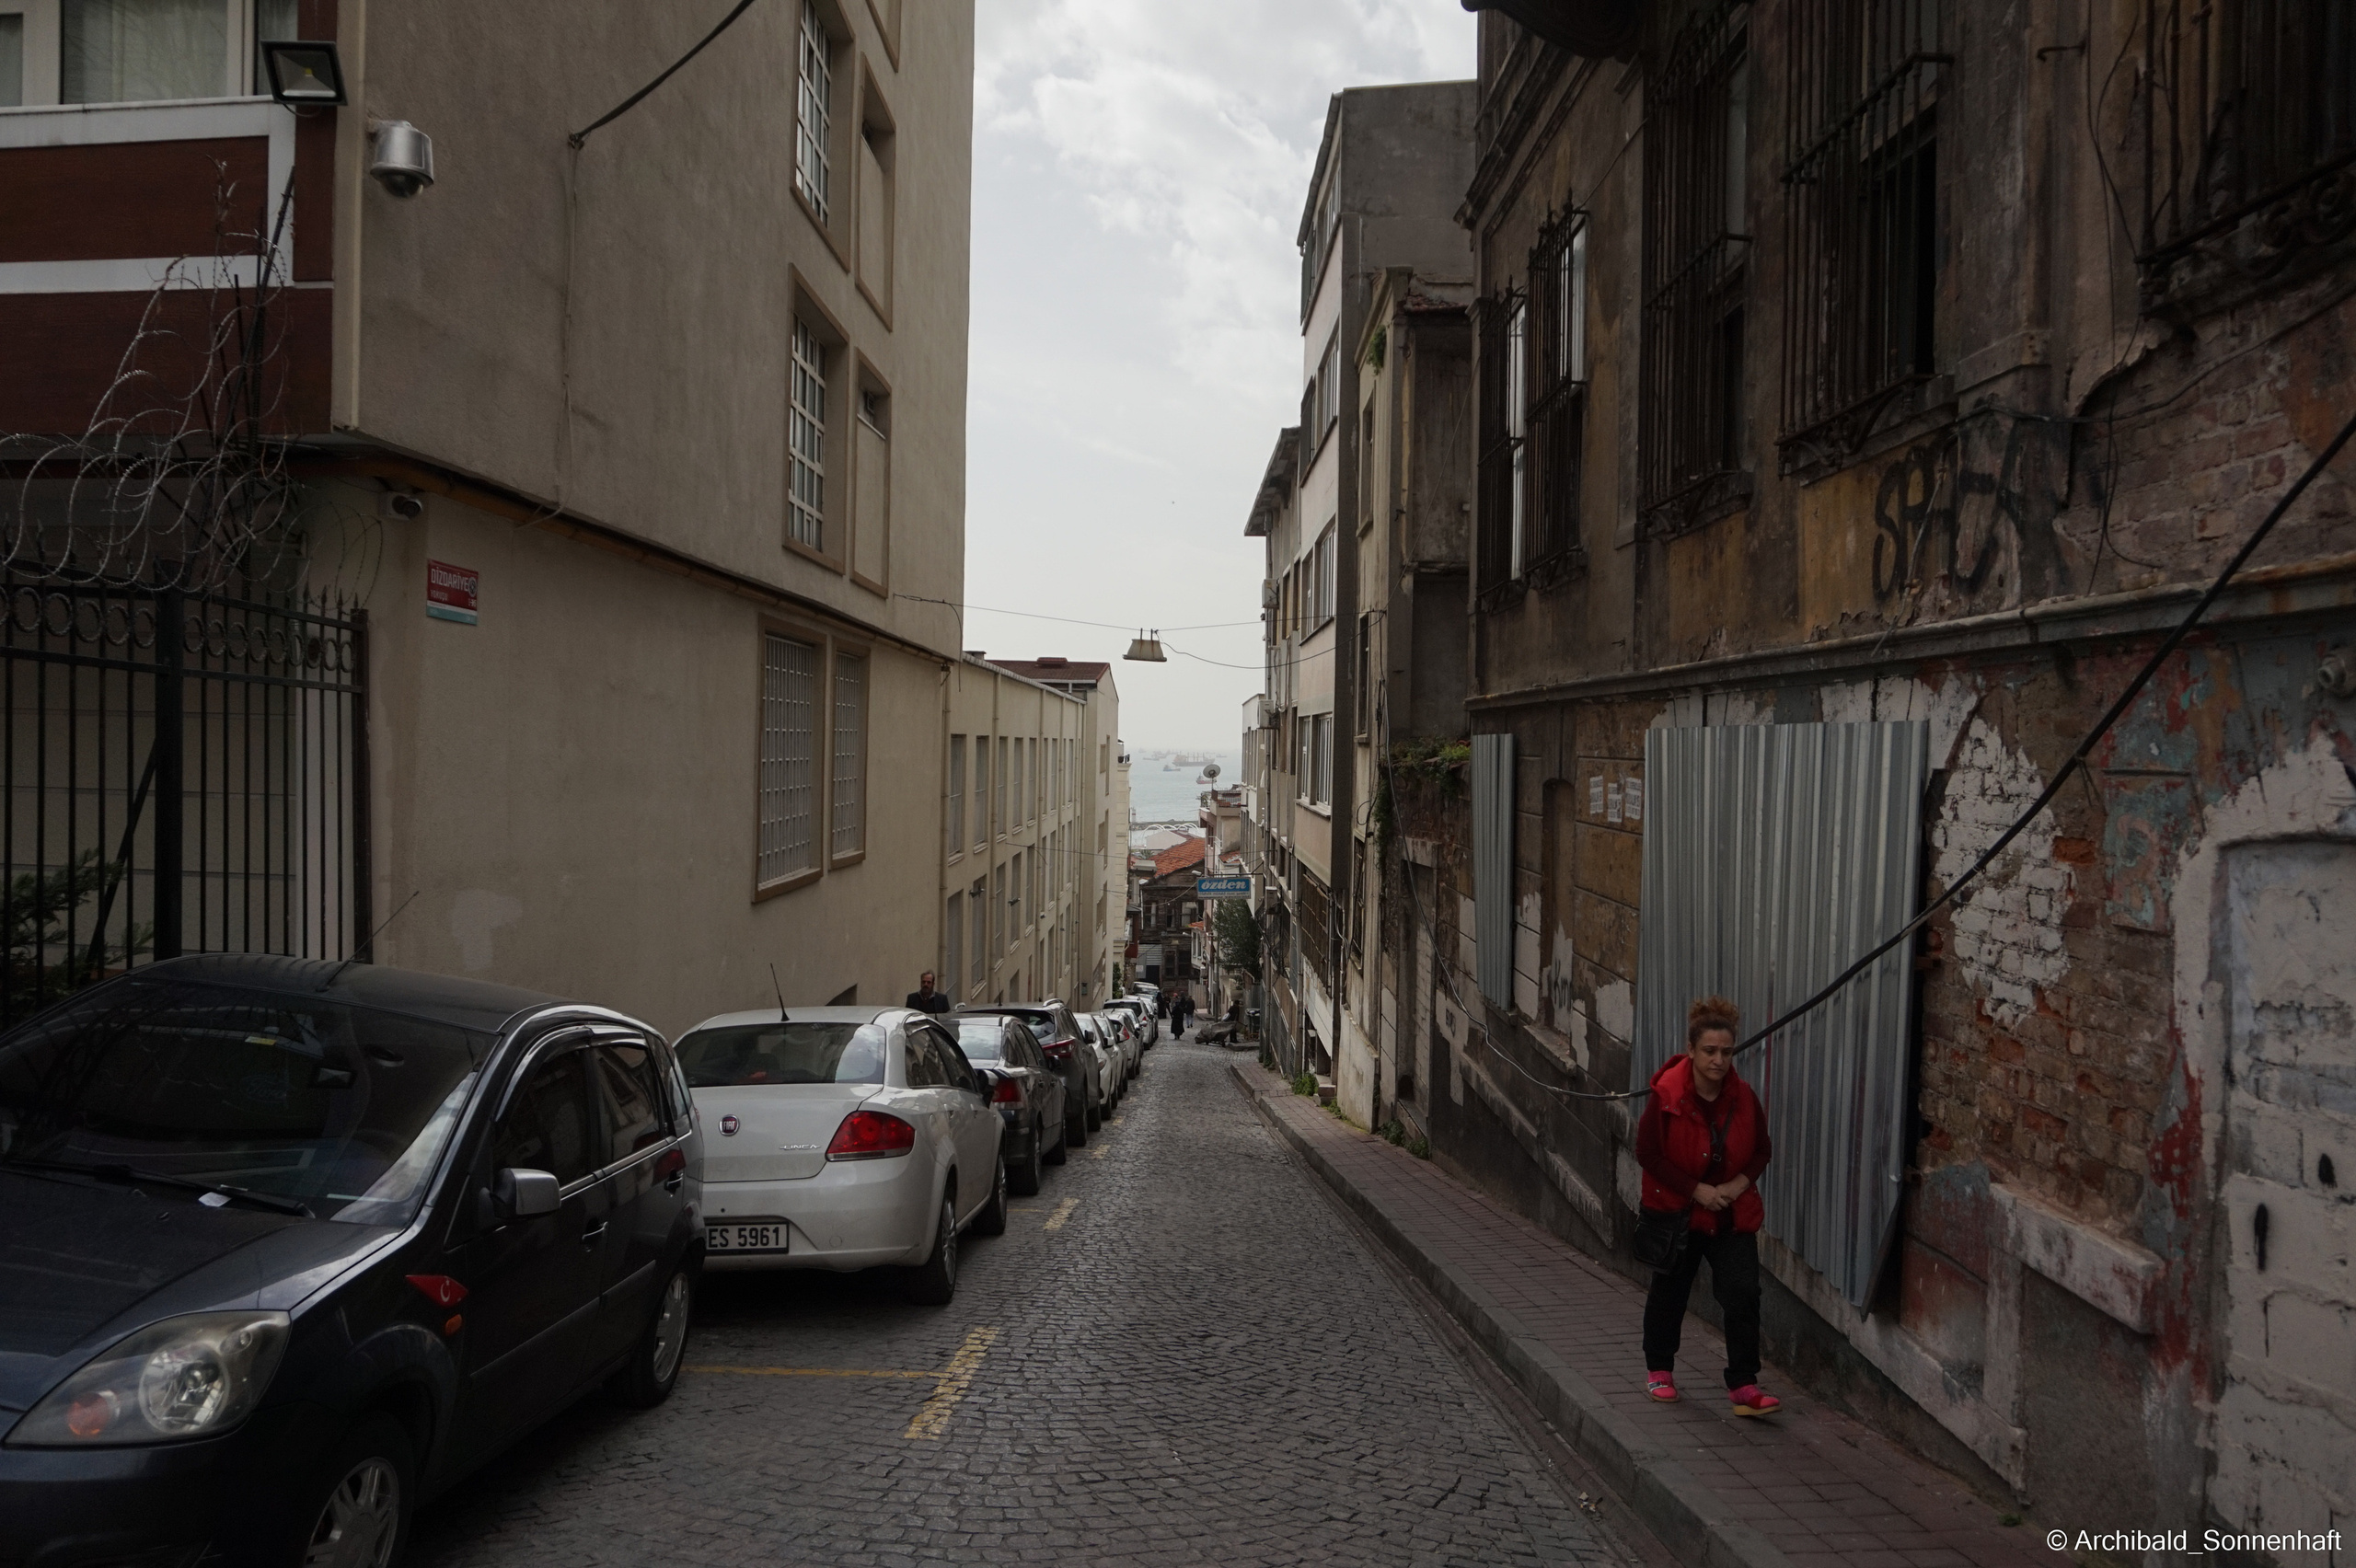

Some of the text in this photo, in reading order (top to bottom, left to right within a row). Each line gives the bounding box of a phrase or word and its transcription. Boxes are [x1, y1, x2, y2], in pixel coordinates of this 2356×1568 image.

[431, 566, 468, 592] DİZDARİYE
[1201, 880, 1246, 890] özden
[723, 1120, 735, 1130] FIAT
[708, 1227, 780, 1248] ES 5961
